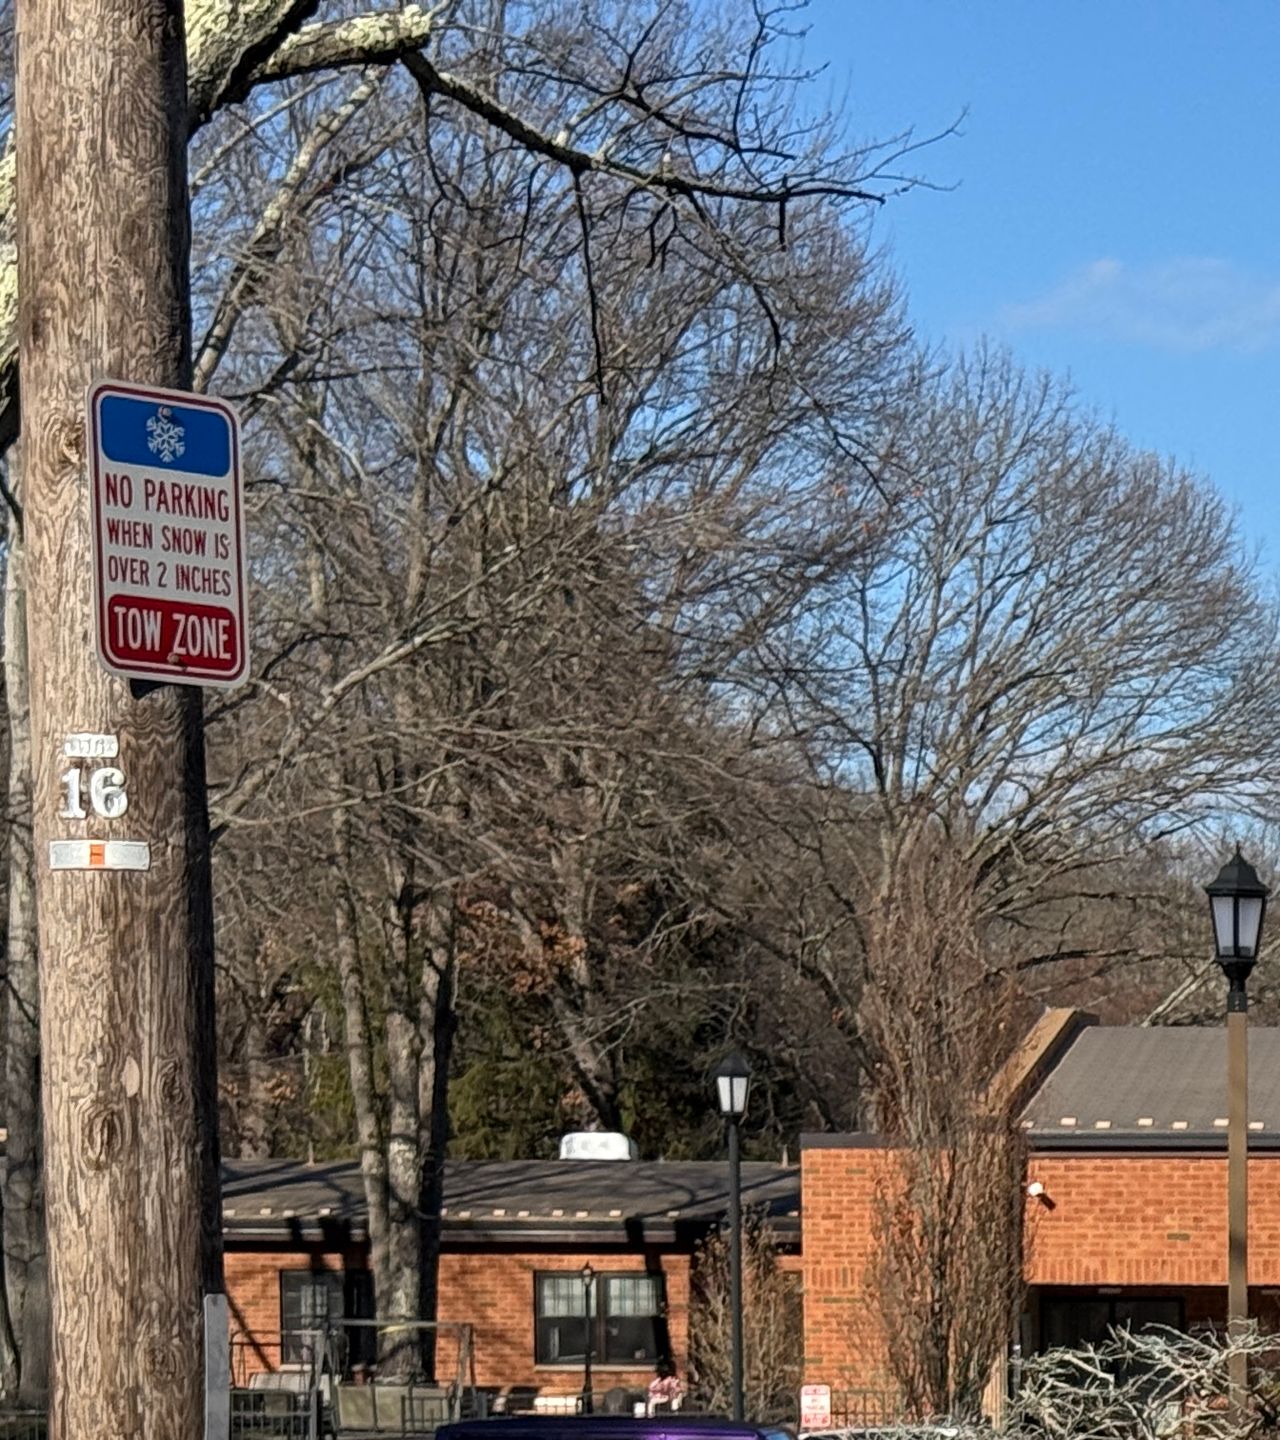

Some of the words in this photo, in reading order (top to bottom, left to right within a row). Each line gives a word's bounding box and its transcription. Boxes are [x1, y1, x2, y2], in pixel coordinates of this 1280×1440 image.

[104, 471, 133, 510] NO
[143, 478, 230, 523] PARKING
[106, 517, 154, 551] WHEN
[161, 524, 208, 557] SNOW
[214, 532, 231, 561] IS
[108, 554, 150, 588] OVER
[157, 560, 168, 588] 2
[175, 563, 232, 598] INCHES
[113, 605, 163, 653] TOW
[172, 612, 232, 661] ZONE
[59, 766, 129, 819] 16
